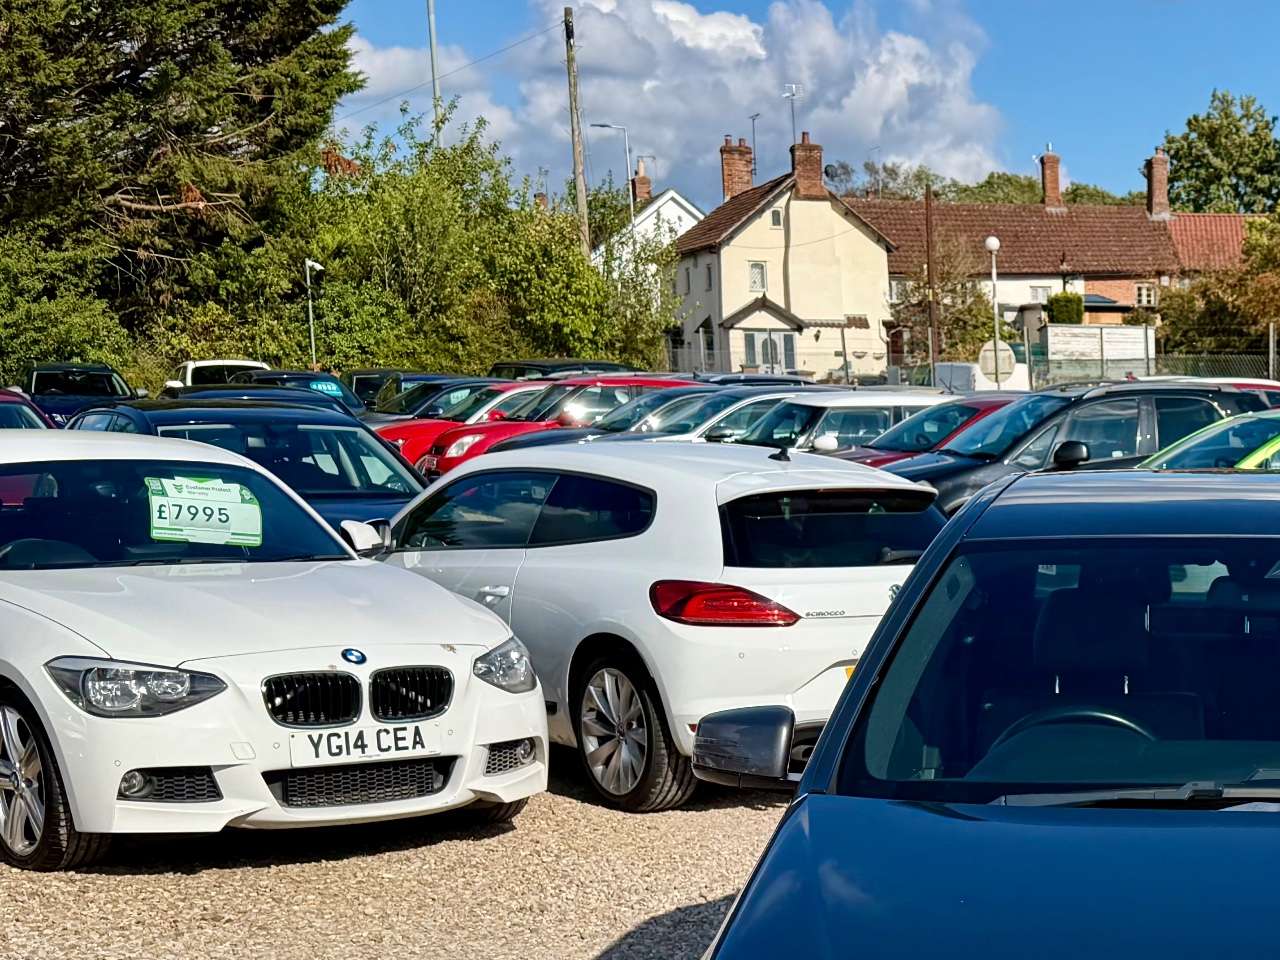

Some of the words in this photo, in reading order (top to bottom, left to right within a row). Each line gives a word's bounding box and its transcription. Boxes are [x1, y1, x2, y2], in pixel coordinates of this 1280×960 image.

[156, 503, 230, 524] £7995
[307, 730, 368, 759] YG14
[376, 725, 426, 753] CEA
